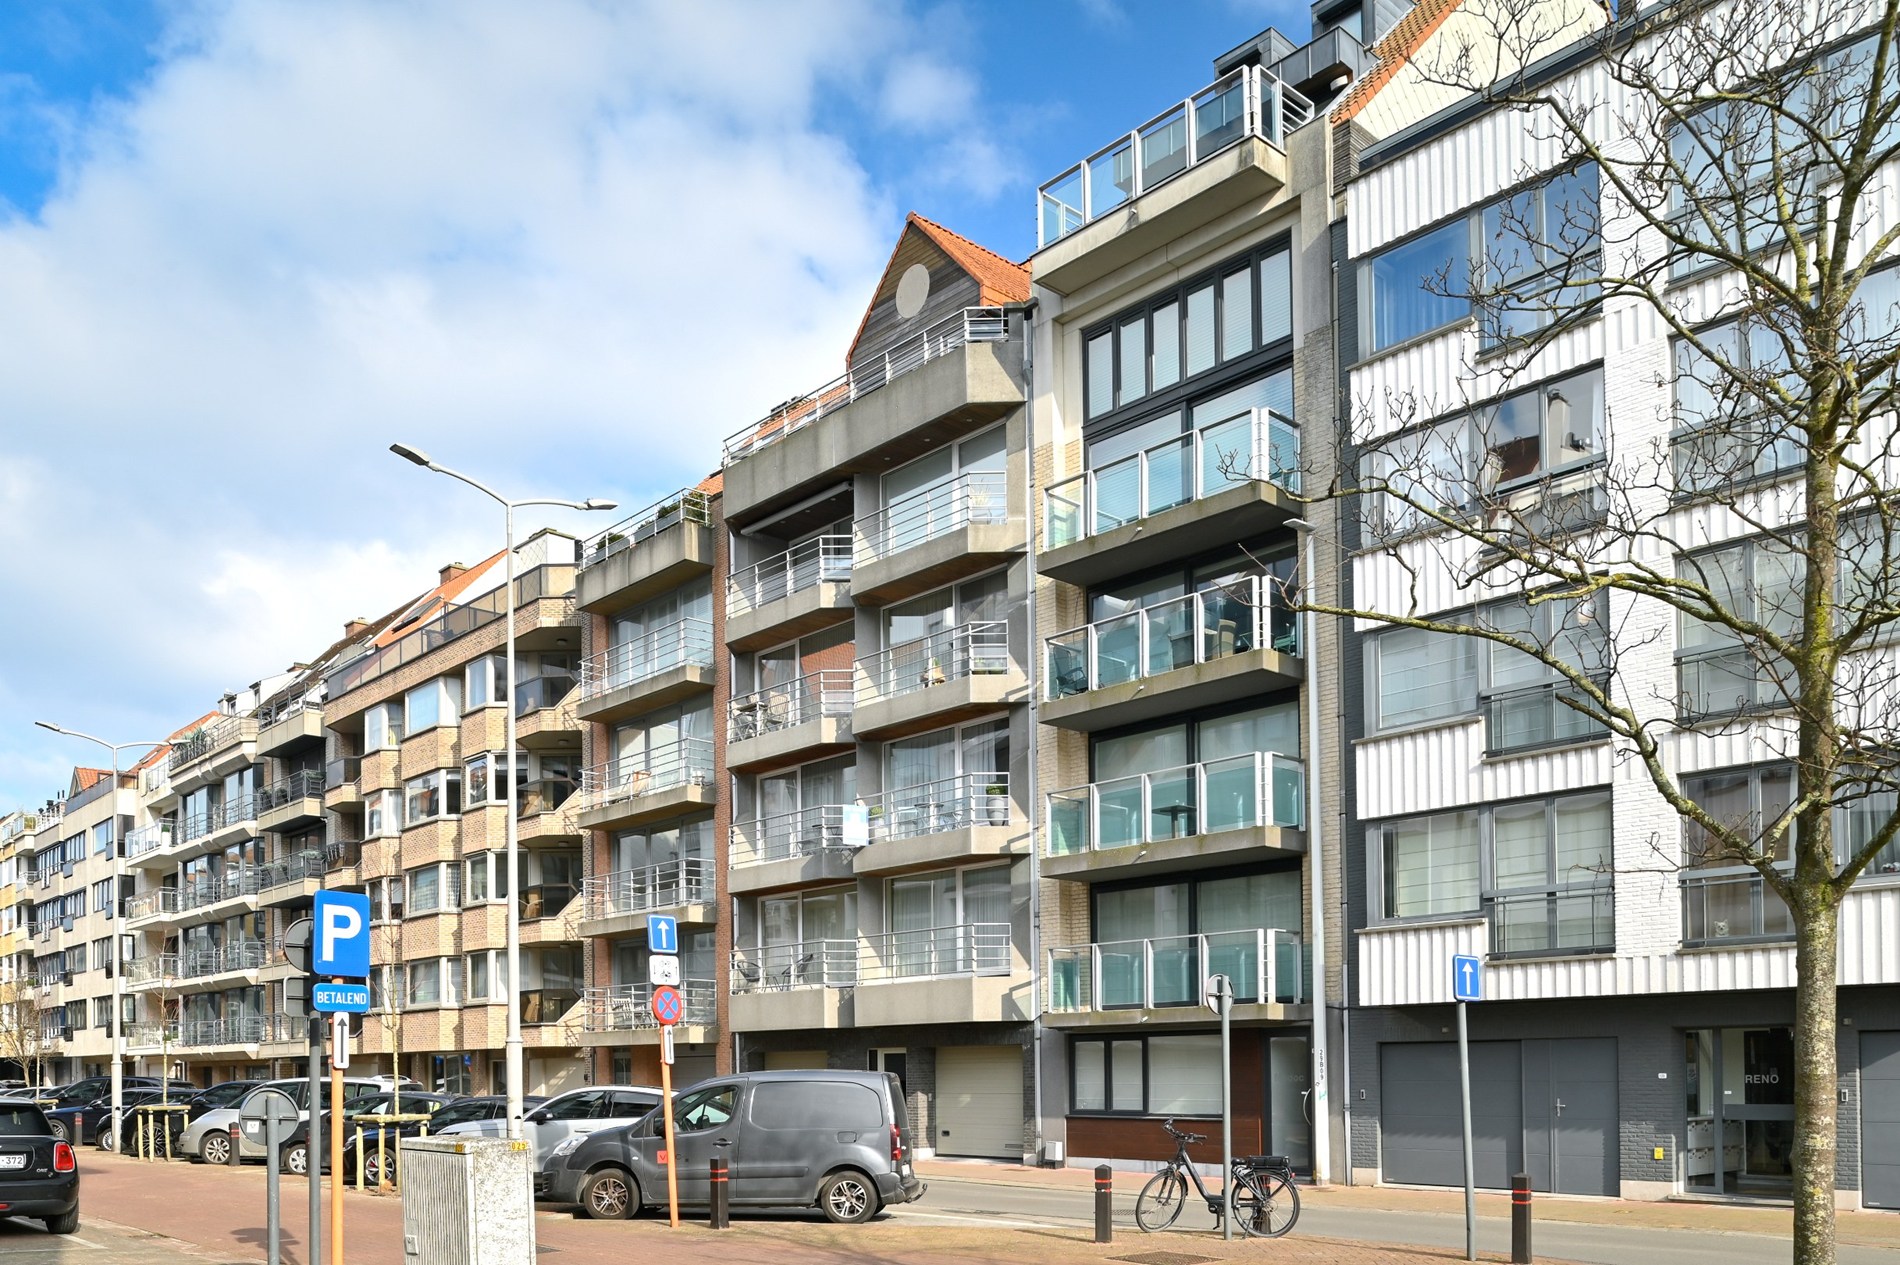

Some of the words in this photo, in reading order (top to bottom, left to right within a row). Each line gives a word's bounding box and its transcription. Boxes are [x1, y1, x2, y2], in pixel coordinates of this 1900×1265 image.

[322, 904, 361, 962] P
[317, 991, 367, 1005] BETALEND
[1745, 1074, 1779, 1084] RENO
